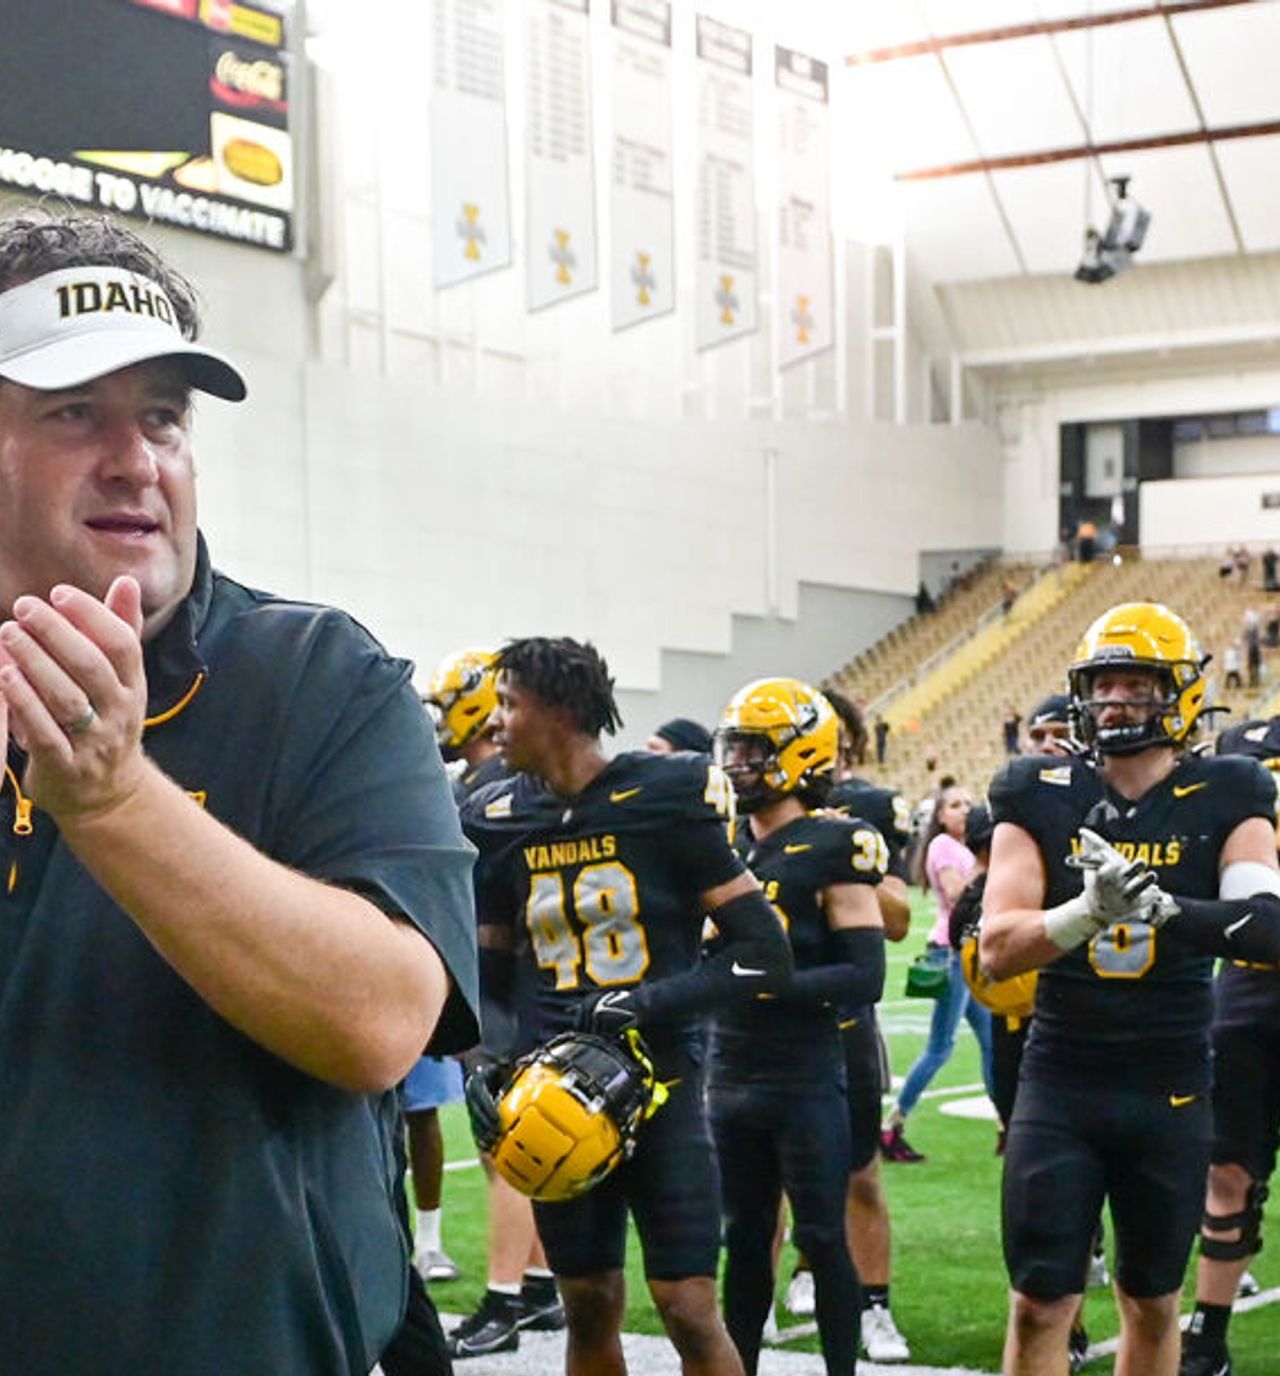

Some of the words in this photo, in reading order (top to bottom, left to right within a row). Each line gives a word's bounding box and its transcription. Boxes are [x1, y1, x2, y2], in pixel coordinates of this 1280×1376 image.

[96, 172, 137, 211] TO
[140, 185, 285, 248] VACCINATE
[57, 281, 174, 326] IDAHO
[524, 835, 616, 870] VANDALS
[526, 860, 651, 990] 48
